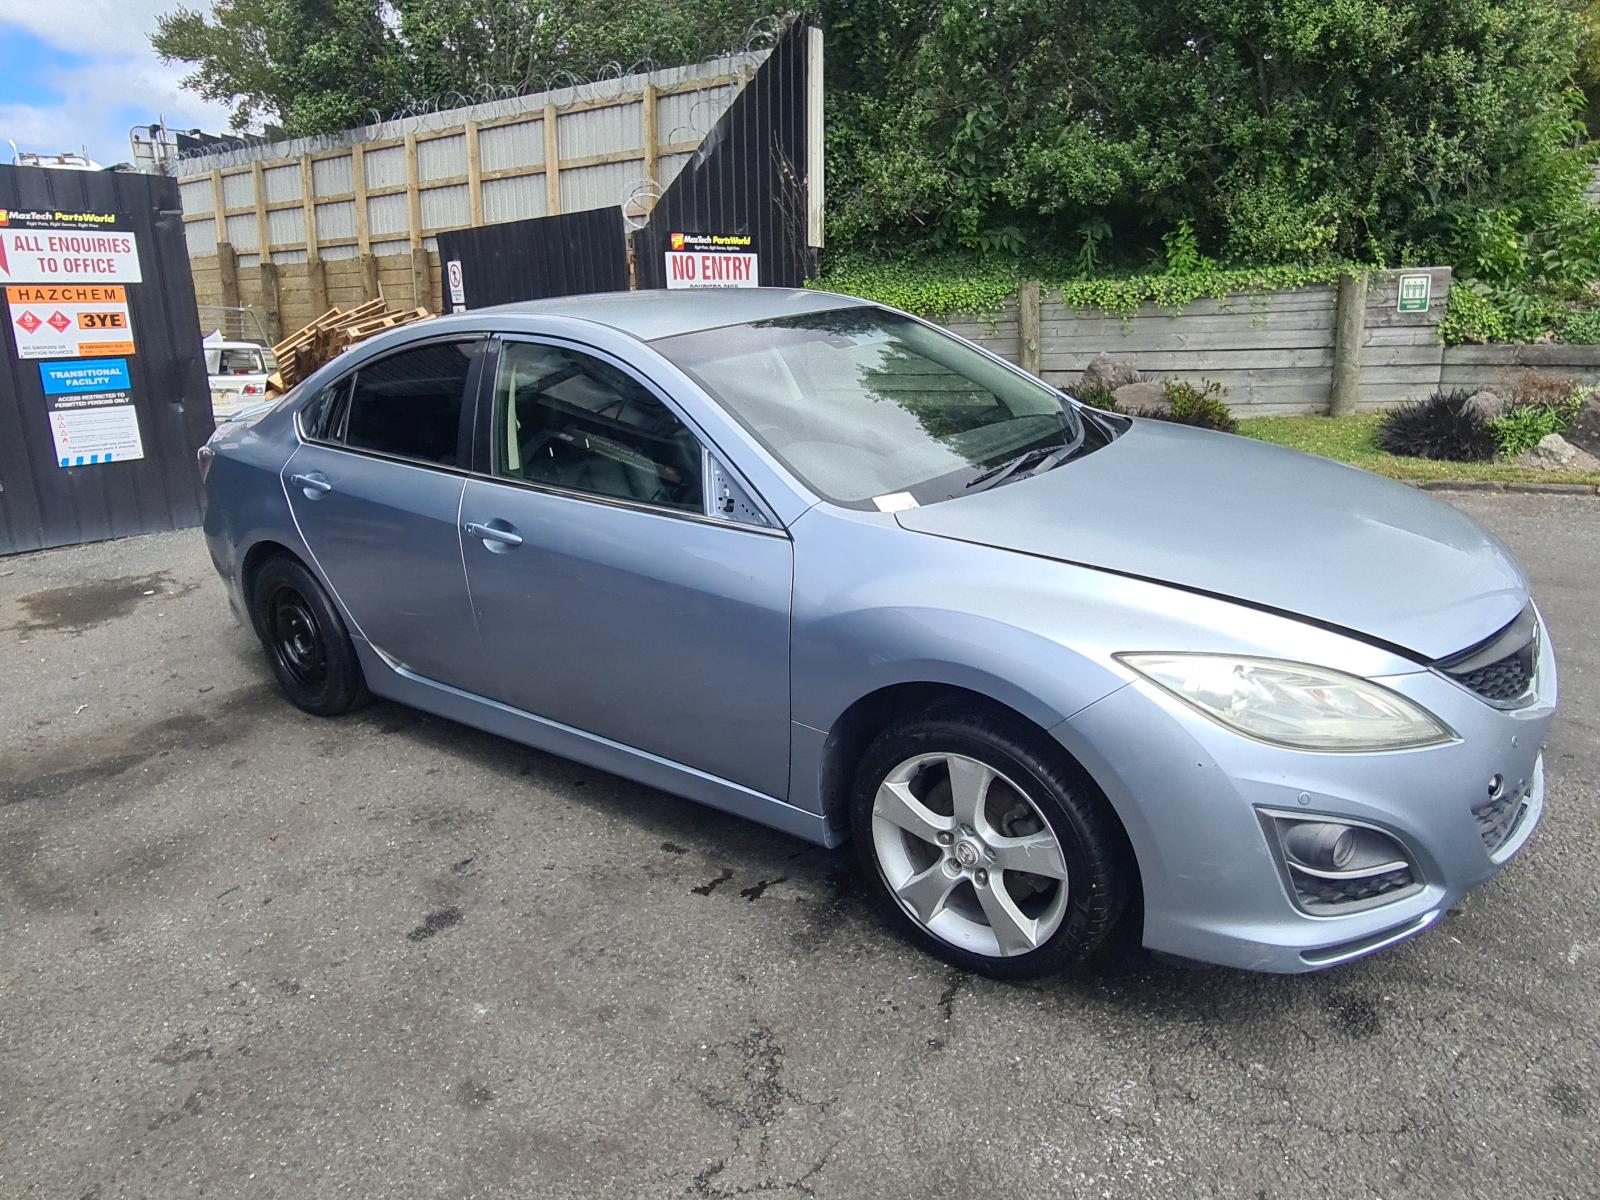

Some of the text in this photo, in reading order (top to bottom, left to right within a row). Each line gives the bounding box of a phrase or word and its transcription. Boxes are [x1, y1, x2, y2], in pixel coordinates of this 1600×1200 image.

[55, 212, 116, 223] PartsWorld
[14, 235, 131, 254] ALL ENQUIRIES
[712, 235, 751, 245] PartsWorld
[37, 257, 116, 273] TO OFFICE
[671, 254, 752, 281] NO ENTRY
[18, 288, 116, 301] HAZCHEM
[83, 313, 122, 328] 3YE
[49, 367, 122, 379] TRANSITIONAL
[65, 377, 110, 386] FACILITY
